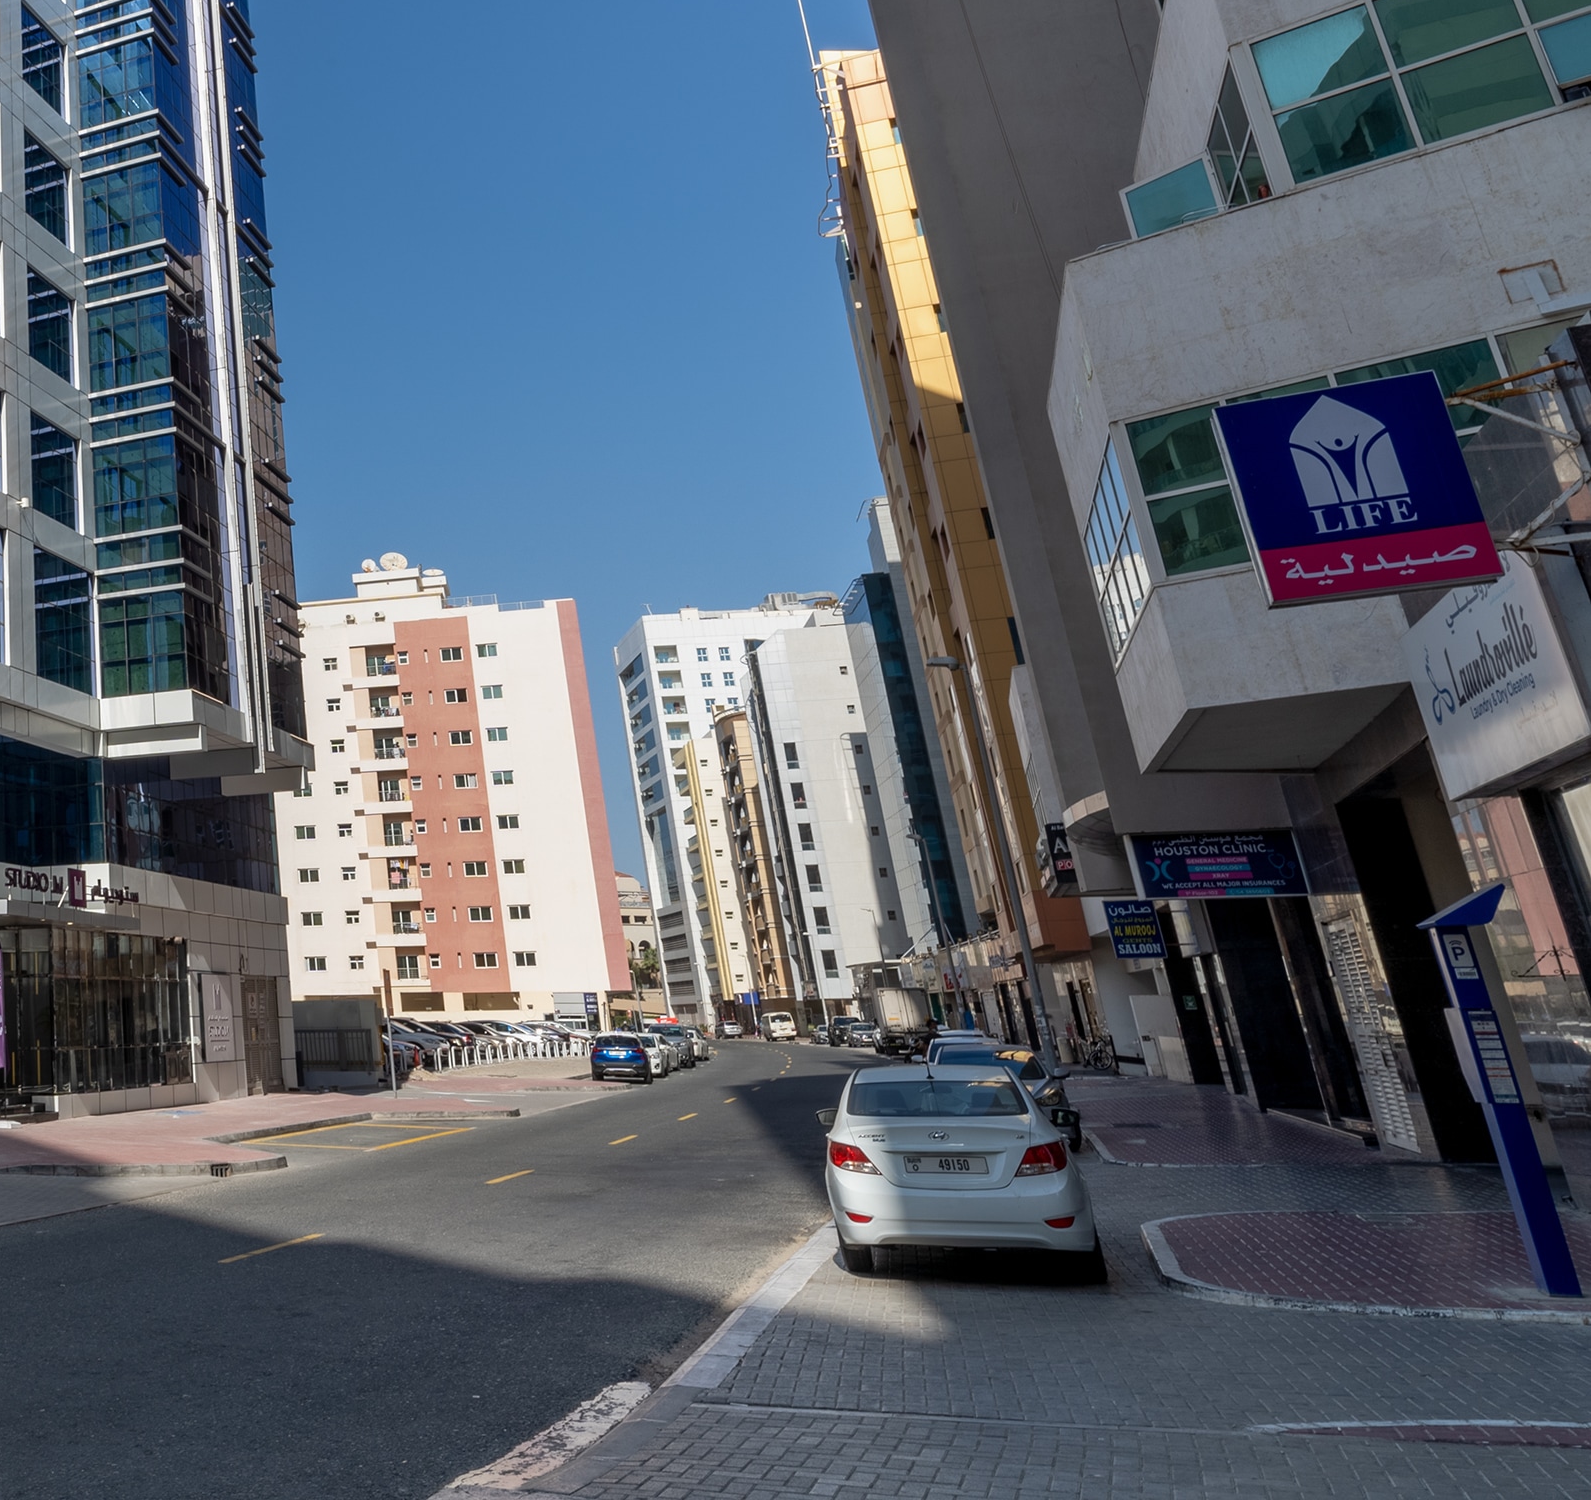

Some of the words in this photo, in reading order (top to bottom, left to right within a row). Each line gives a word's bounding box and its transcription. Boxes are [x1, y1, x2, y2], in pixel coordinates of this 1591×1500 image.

[1310, 497, 1418, 534] LIFE
[1280, 544, 1477, 585] صيدلية
[1470, 697, 1494, 720] Laundry
[1496, 688, 1509, 704] Dry
[1507, 673, 1536, 696] Cleaning
[1154, 844, 1219, 856] HOUSTON
[1222, 843, 1267, 854] CLINIC
[5, 868, 49, 893] STUDIO
[1242, 879, 1286, 887] INSURANCES
[1108, 904, 1152, 916] صالون
[1114, 925, 1124, 937] AL
[1124, 924, 1156, 937] MUROOJ
[1117, 943, 1162, 954] SALOON
[1451, 947, 1465, 961] P
[939, 1158, 970, 1171] 49150
